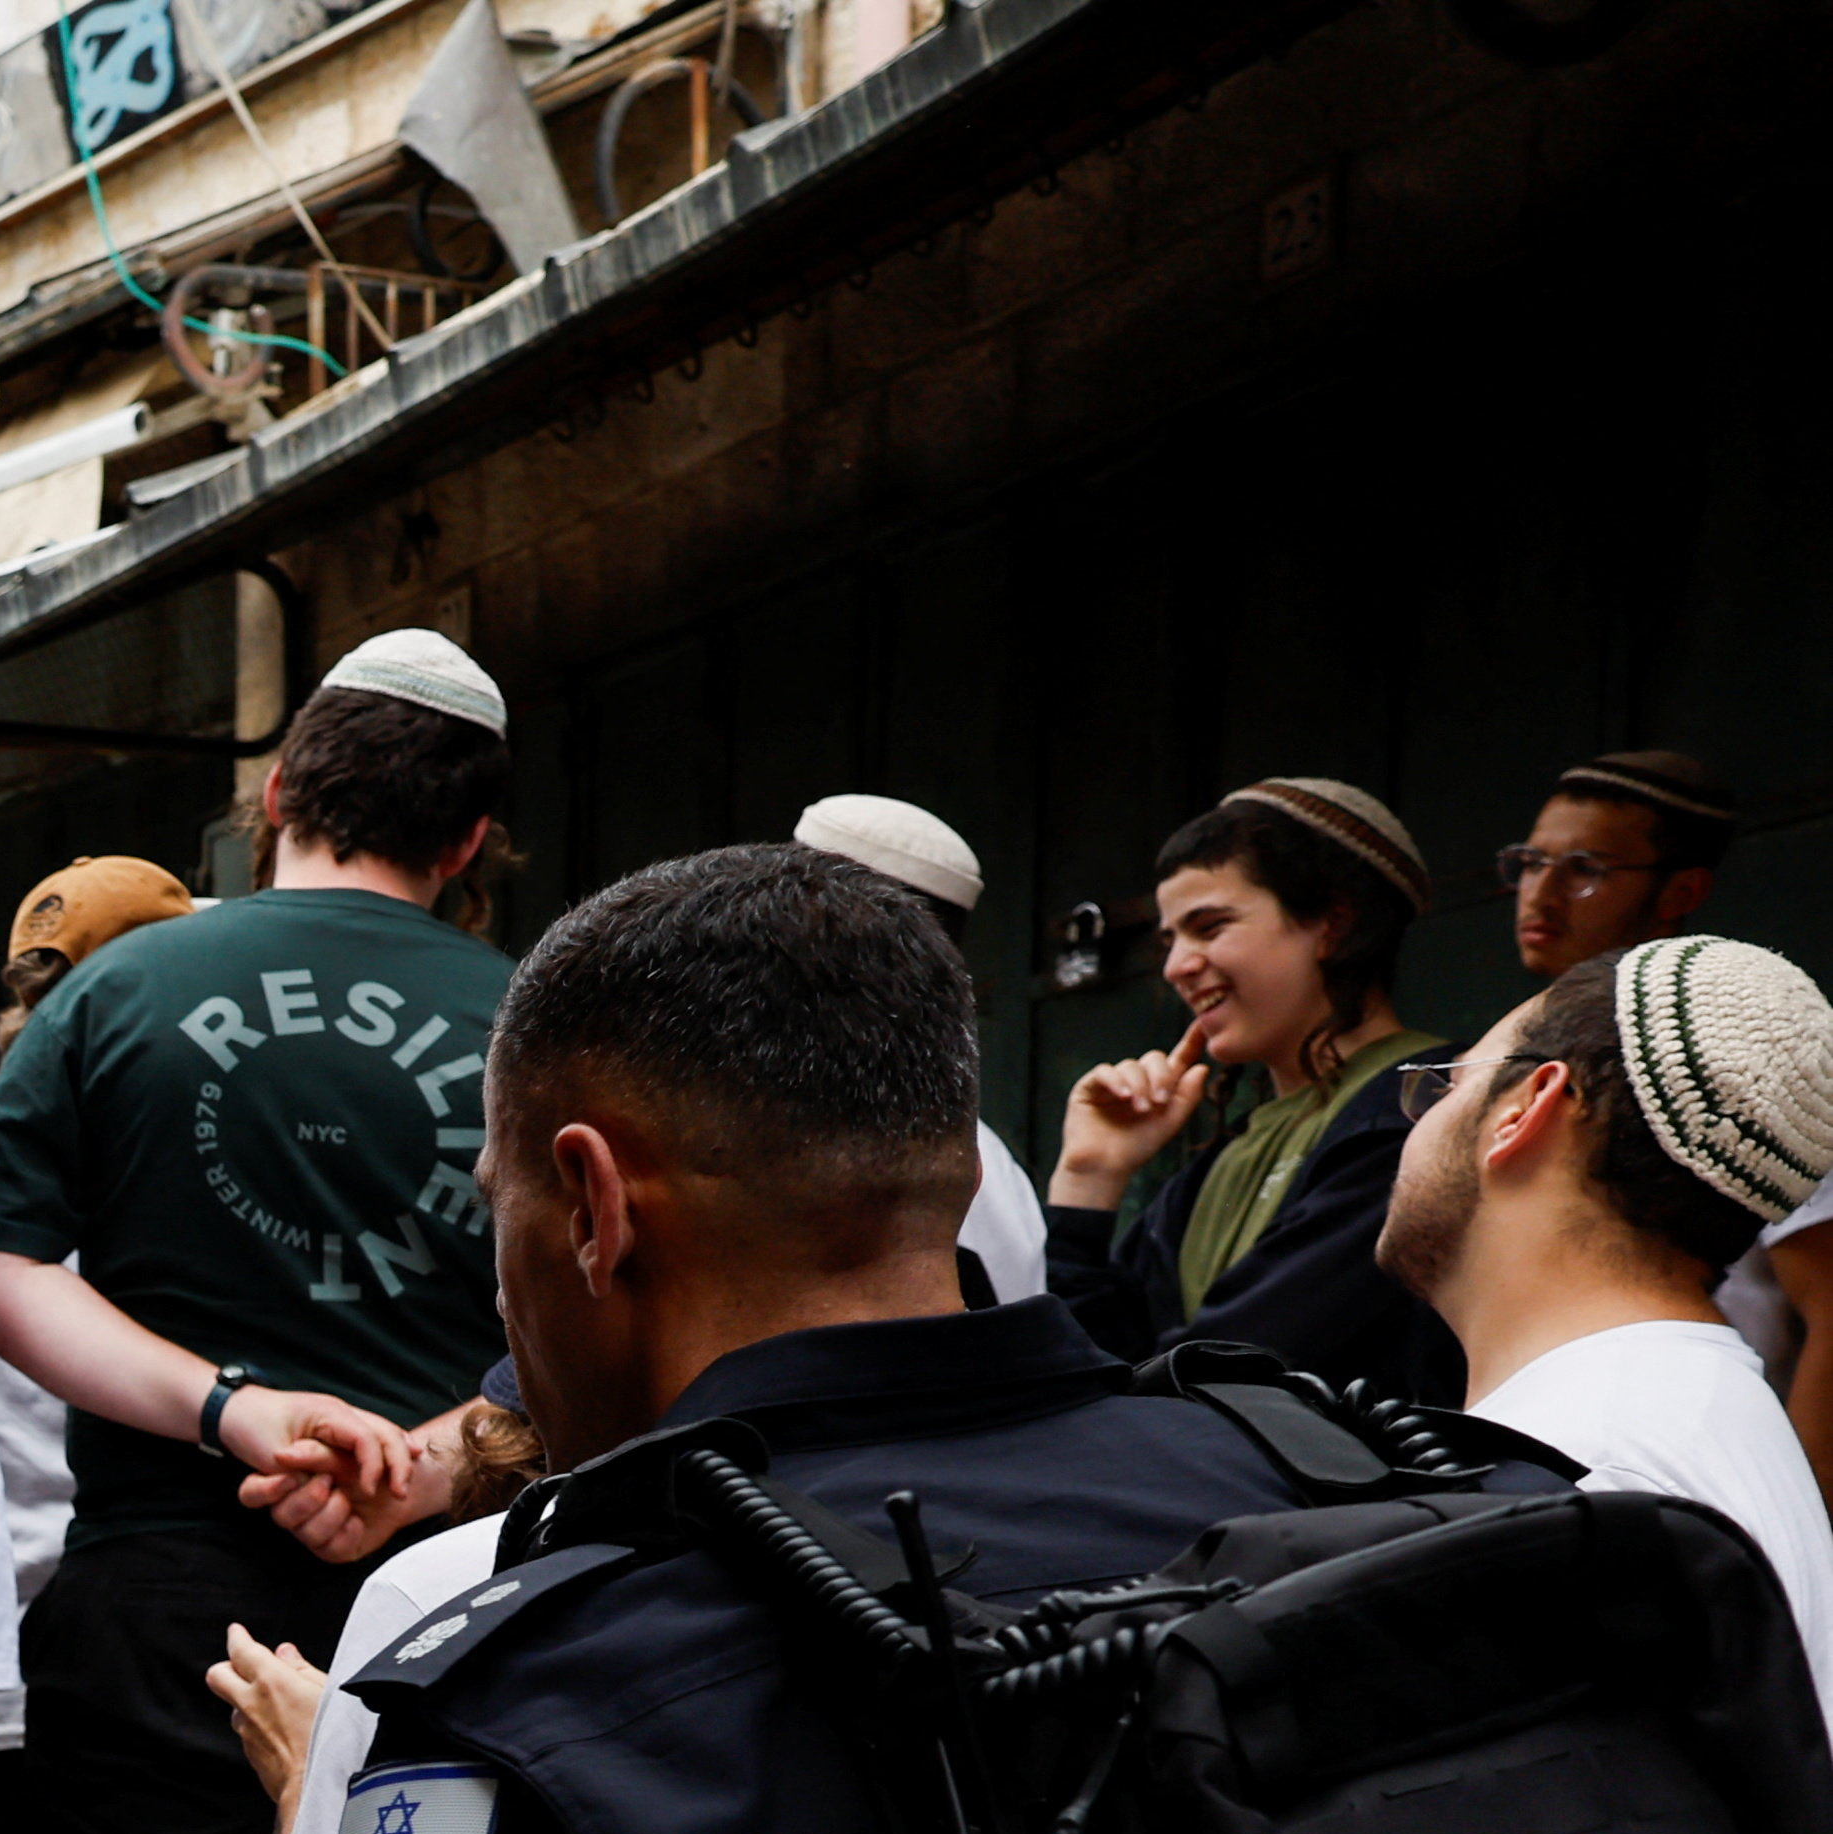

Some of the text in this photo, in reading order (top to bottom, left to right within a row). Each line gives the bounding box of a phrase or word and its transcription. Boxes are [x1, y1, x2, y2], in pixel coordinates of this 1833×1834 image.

[178, 968, 490, 1301] RESILIENT
[194, 1081, 312, 1252] WINTER 1979
[297, 1122, 347, 1145] NYC
